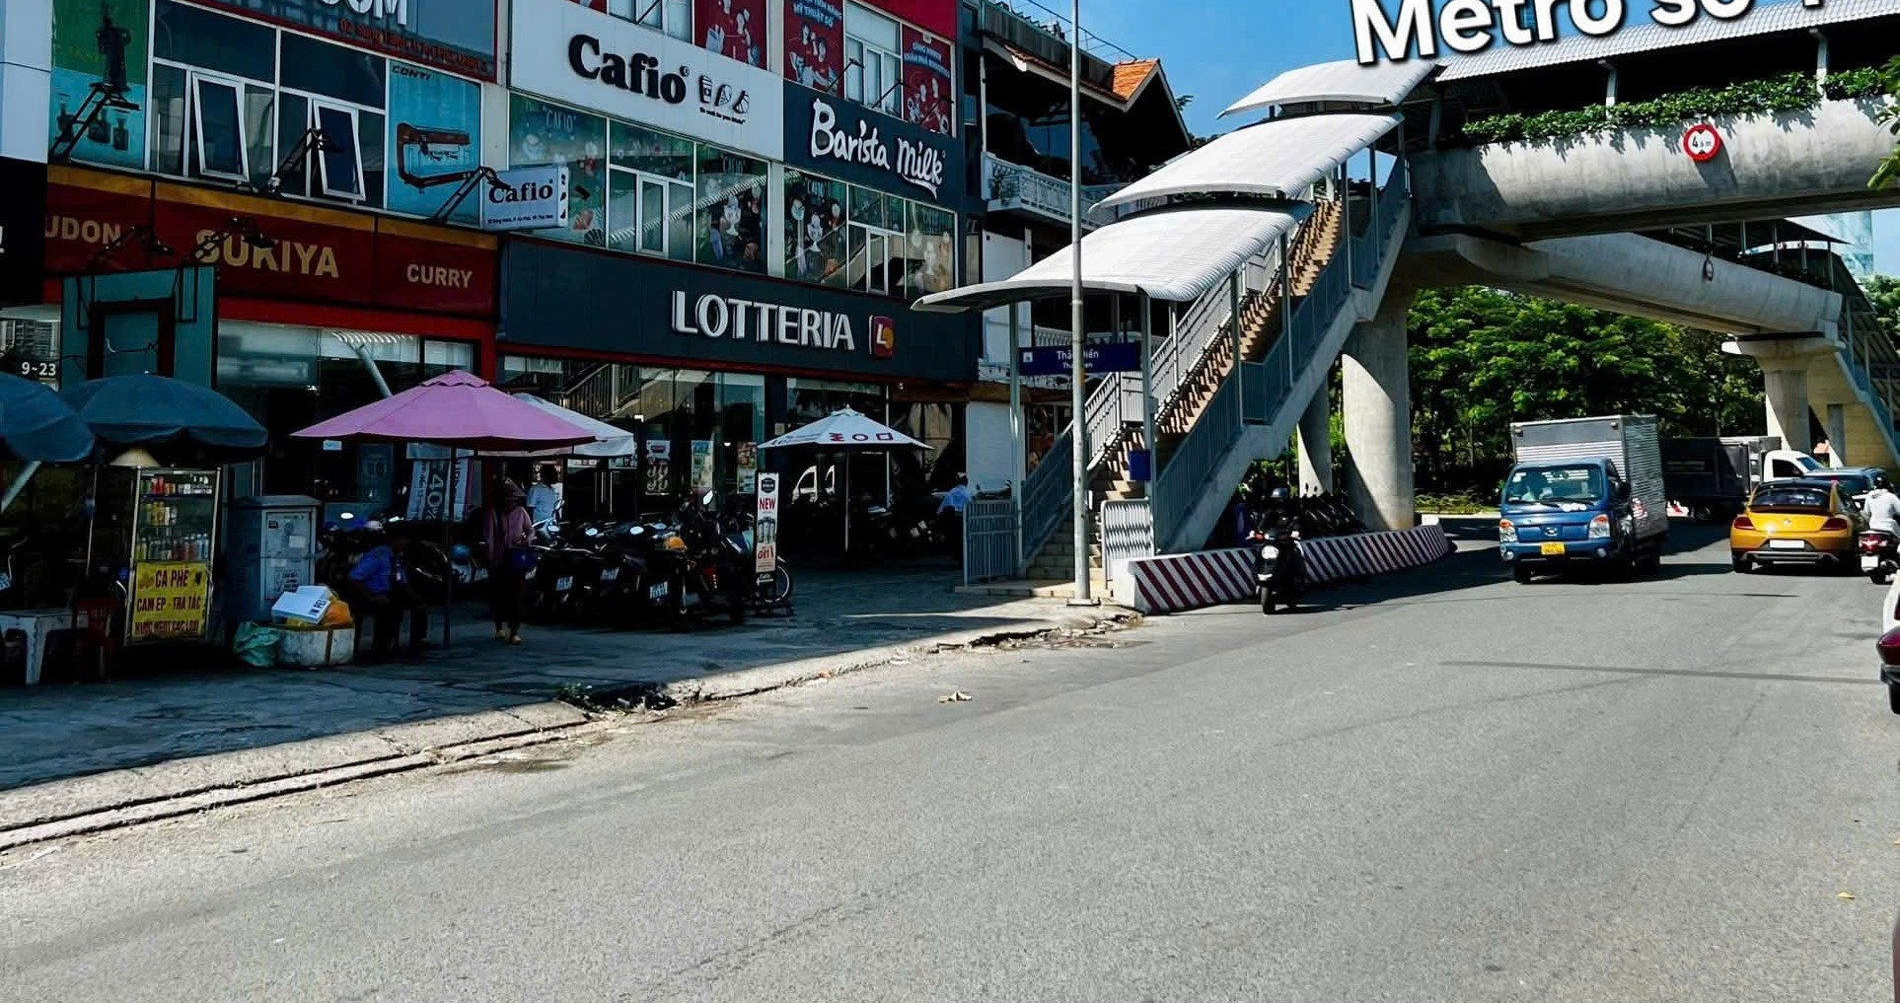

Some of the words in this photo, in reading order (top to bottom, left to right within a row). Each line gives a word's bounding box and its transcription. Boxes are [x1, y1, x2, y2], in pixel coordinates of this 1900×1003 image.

[568, 34, 687, 104] Cafio
[811, 97, 890, 170] Barista
[489, 182, 553, 204] Cafio
[194, 228, 341, 279] SUKIYA
[406, 263, 474, 290] CURRY
[671, 290, 857, 352] LOTTERIA
[759, 498, 776, 511] NEW
